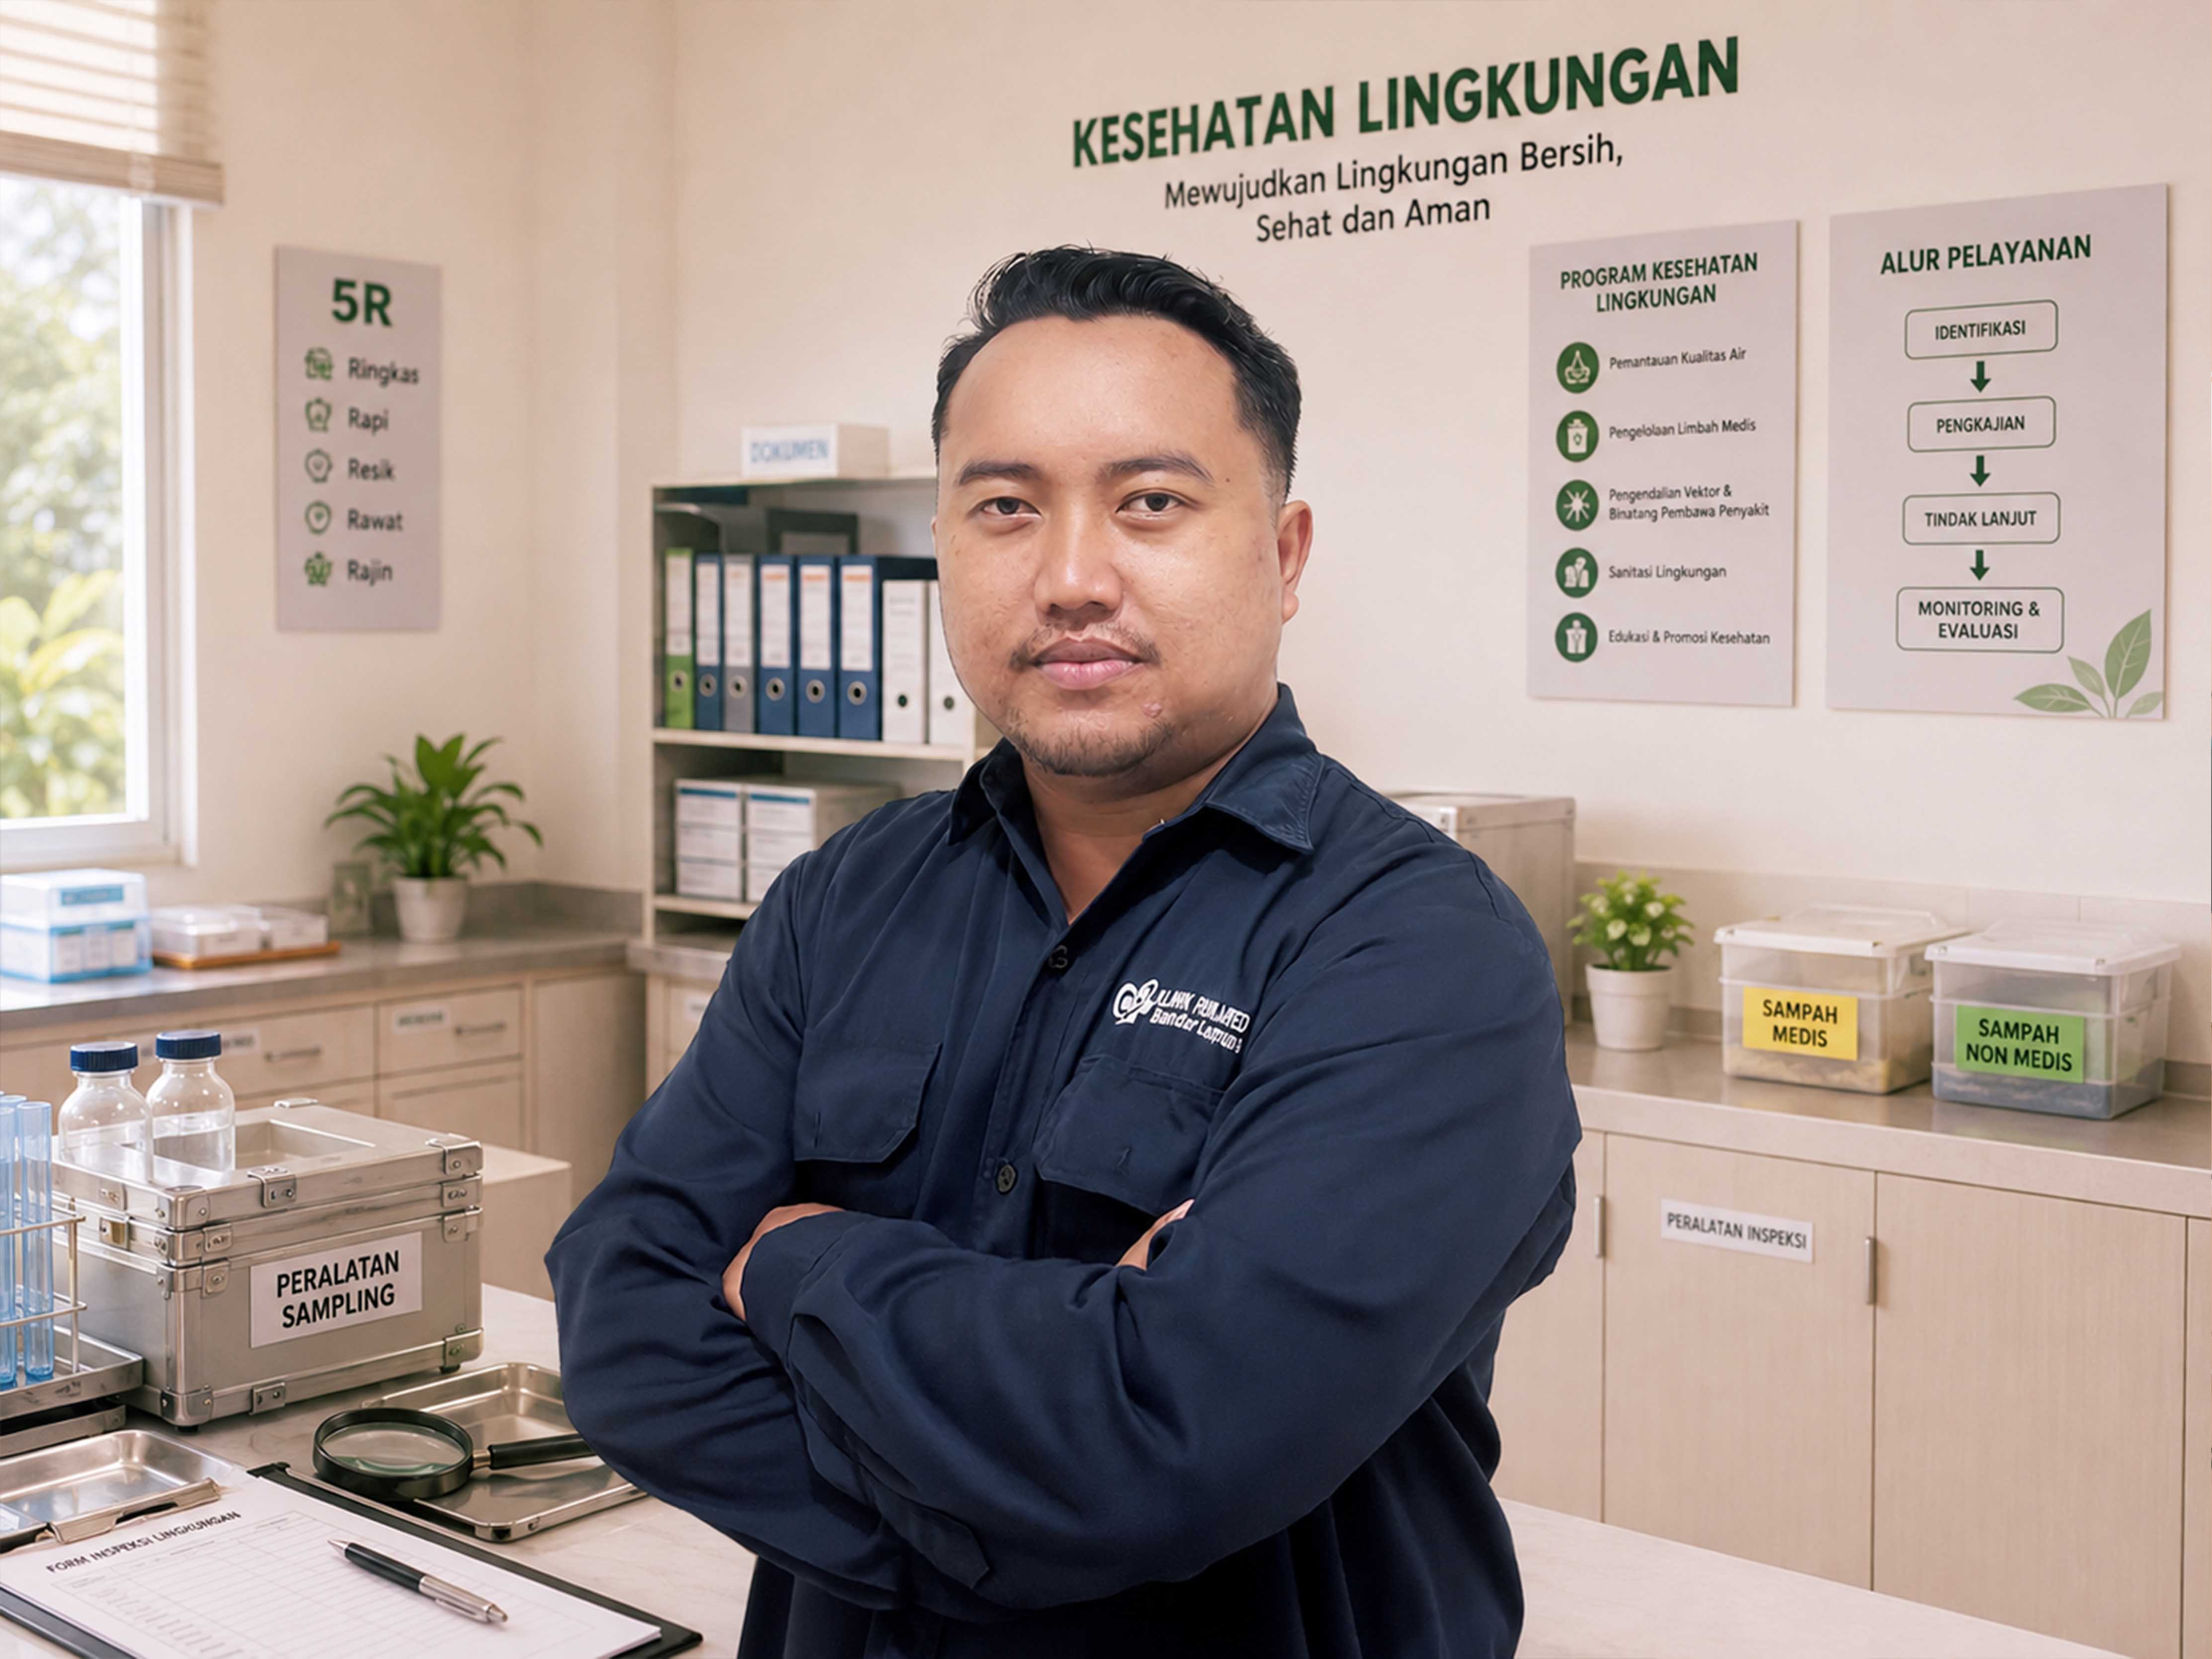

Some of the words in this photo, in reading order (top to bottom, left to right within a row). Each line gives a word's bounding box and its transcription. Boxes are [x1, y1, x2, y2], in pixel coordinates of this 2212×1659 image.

[1072, 86, 1335, 168] KESEHATAN
[1358, 36, 1740, 134] LINGKUNGAN
[1164, 169, 1326, 210] Mewujudkan
[1335, 151, 1508, 196] Lingkungan
[1520, 130, 1624, 174] Bersih,
[1255, 212, 1332, 243] Sehat
[1341, 202, 1396, 236] dan
[1404, 195, 1491, 229] Aman
[1880, 248, 1941, 275] ALUR
[1948, 234, 2092, 269] PELAYANAN
[1560, 263, 1646, 290] PROGRAM
[1652, 252, 1758, 281] KESEHATAN
[331, 277, 393, 327] 5R
[1596, 283, 1717, 313] LINGKUNGAN
[1935, 320, 2026, 341] IDENTIFIKASI
[348, 357, 420, 388] Ringkas
[1609, 354, 1678, 370] Pemantauan
[1681, 349, 1726, 363] Kualitas
[1729, 348, 1747, 360] Air
[348, 408, 389, 436] Rapi
[1609, 423, 1675, 441] Pengelolaan
[1678, 421, 1718, 436] Limbah
[1721, 418, 1756, 432] Medis
[1937, 415, 2026, 434] PENGKAJIAN
[348, 458, 395, 481] Resik
[1609, 487, 1681, 504] Pengendalian
[1684, 485, 1721, 499] Vektor
[1723, 485, 1732, 497] &
[347, 510, 403, 531] Rawat
[1609, 507, 1658, 523] Binatang
[1661, 505, 1716, 519] Pembawa
[1719, 502, 1770, 521] Penyakit
[1925, 511, 1977, 527] TINDAK
[1981, 510, 2038, 527] LANJUT
[347, 559, 393, 587] Rajin
[1609, 566, 1653, 579] Sanitasi
[1656, 565, 1727, 582] Lingkungan
[1918, 601, 2024, 616] MONITORING
[2028, 602, 2041, 616] &
[1609, 630, 1650, 643] Edukasi
[1652, 630, 1660, 643] &
[1664, 630, 1708, 643] Promosi
[1710, 630, 1771, 644] Kesehatan
[1938, 622, 2019, 639] EVALUASI
[1762, 999, 1839, 1025] SAMPAH
[1772, 1025, 1829, 1048] MEDIS
[1978, 1018, 2060, 1045] SAMPAH
[1965, 1044, 2008, 1065] NON
[2014, 1048, 2073, 1072] MEDIS
[1667, 1212, 1743, 1239] PERALATAN
[1748, 1225, 1807, 1249] INSPEKSI
[277, 1250, 400, 1298] PERALATAN
[282, 1283, 395, 1328] SAMPLING
[46, 1555, 90, 1573] FORM
[90, 1536, 154, 1561] INSPEKSI
